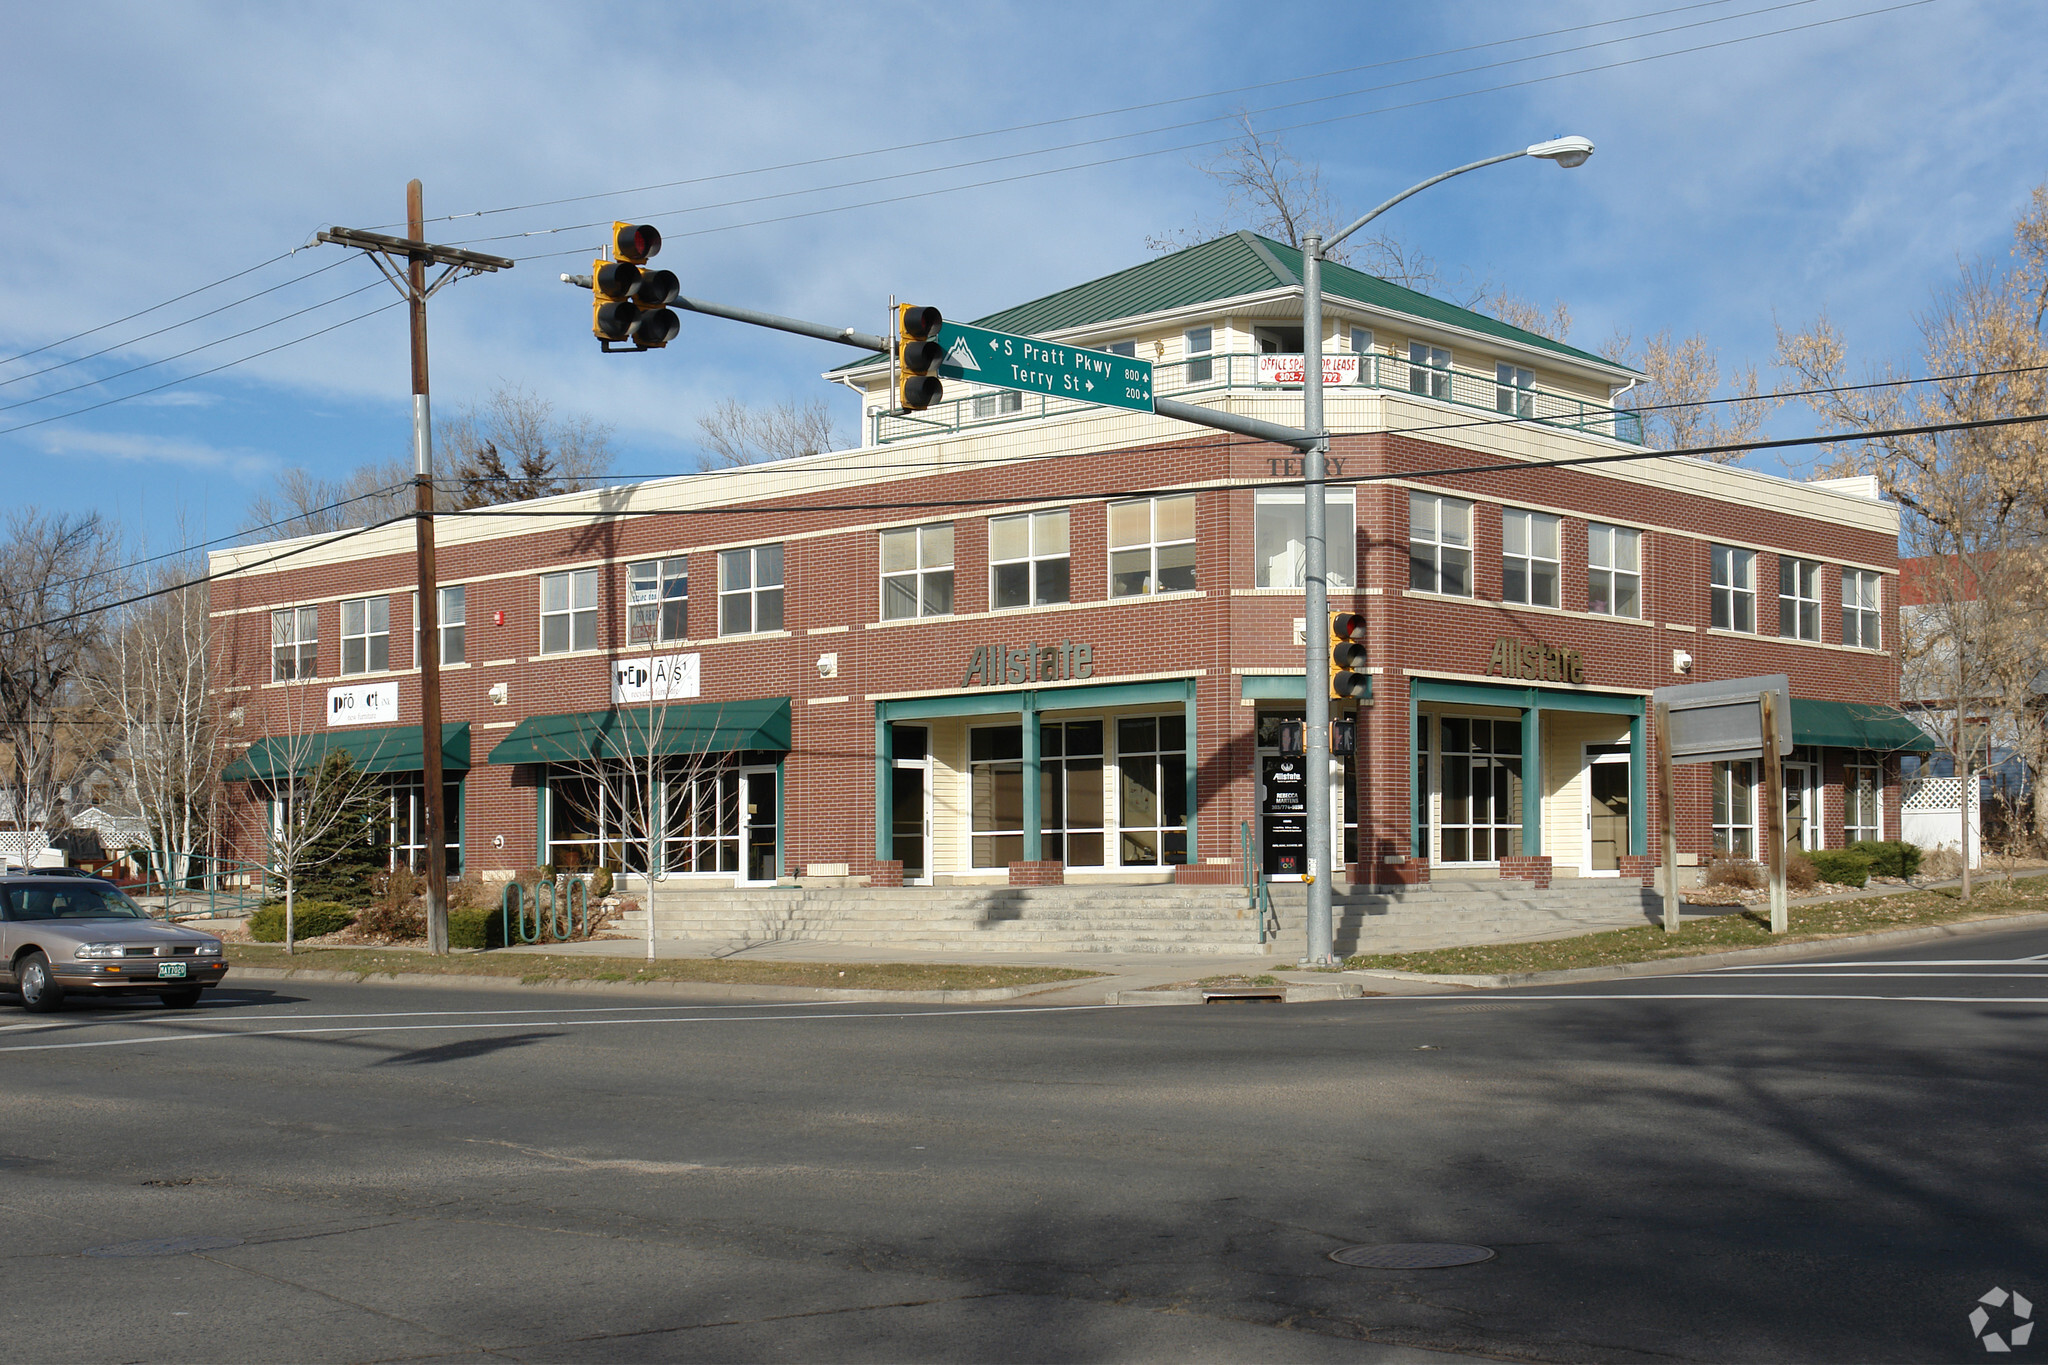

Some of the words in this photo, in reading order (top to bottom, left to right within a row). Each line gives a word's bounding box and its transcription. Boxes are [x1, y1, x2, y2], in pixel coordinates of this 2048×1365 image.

[1004, 339, 1013, 356] S
[1024, 343, 1065, 366] Pratt
[1075, 353, 1112, 379] Pkwy
[1260, 358, 1287, 371] OFFICE
[1333, 359, 1356, 371] LEASE
[1011, 364, 1053, 391] Terry
[1064, 374, 1080, 392] St
[1124, 368, 1140, 382] 800
[1125, 387, 1141, 400] 200
[961, 638, 1093, 688] Allstate
[1485, 636, 1584, 685] Allstate
[1272, 772, 1302, 781] Allstate
